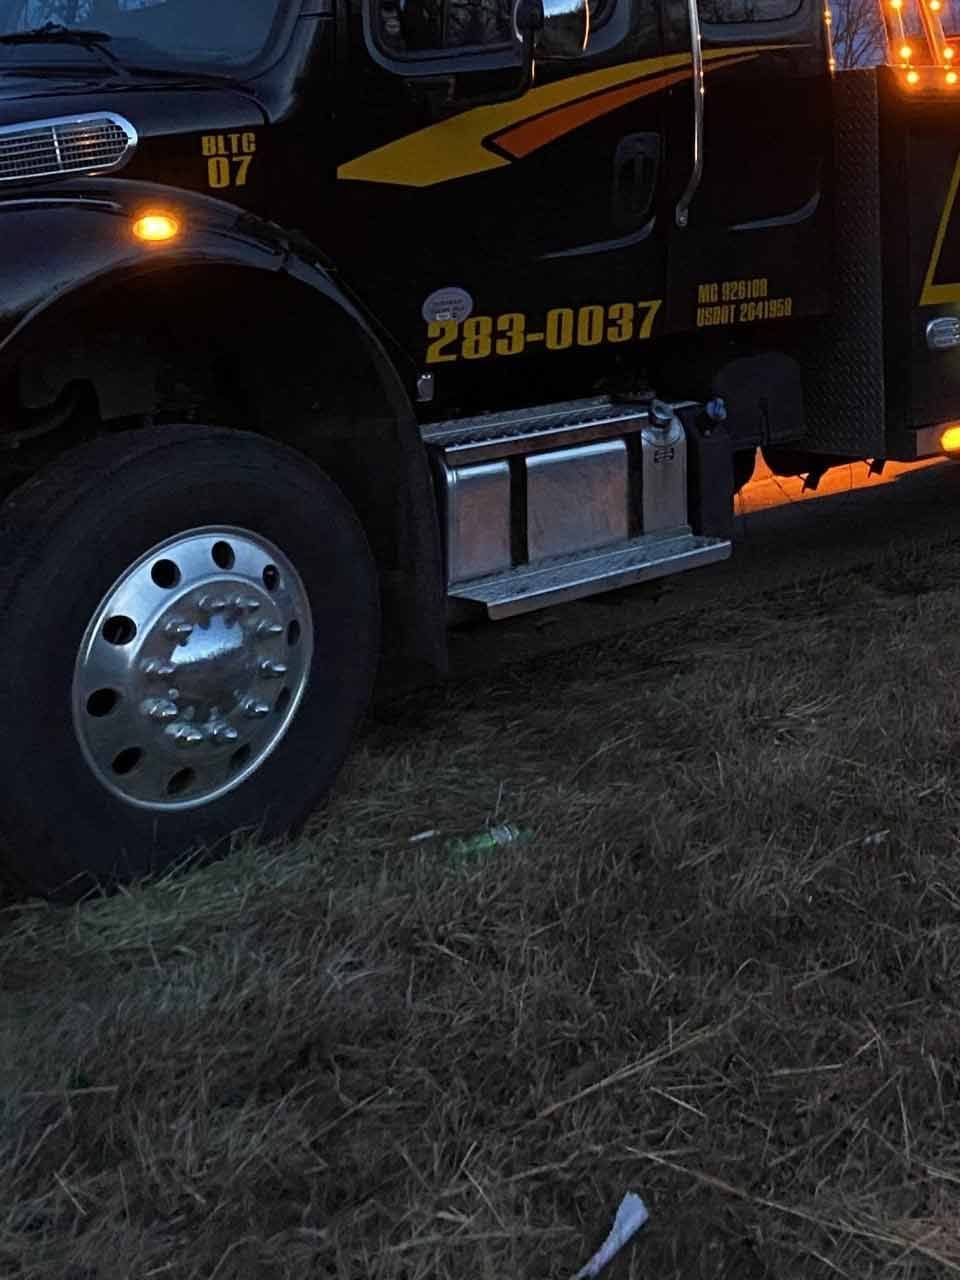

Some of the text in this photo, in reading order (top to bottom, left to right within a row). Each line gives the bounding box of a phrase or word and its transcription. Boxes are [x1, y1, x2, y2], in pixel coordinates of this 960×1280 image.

[202, 132, 256, 156] BLTC
[208, 155, 252, 188] 07
[425, 299, 662, 363] 283-0037
